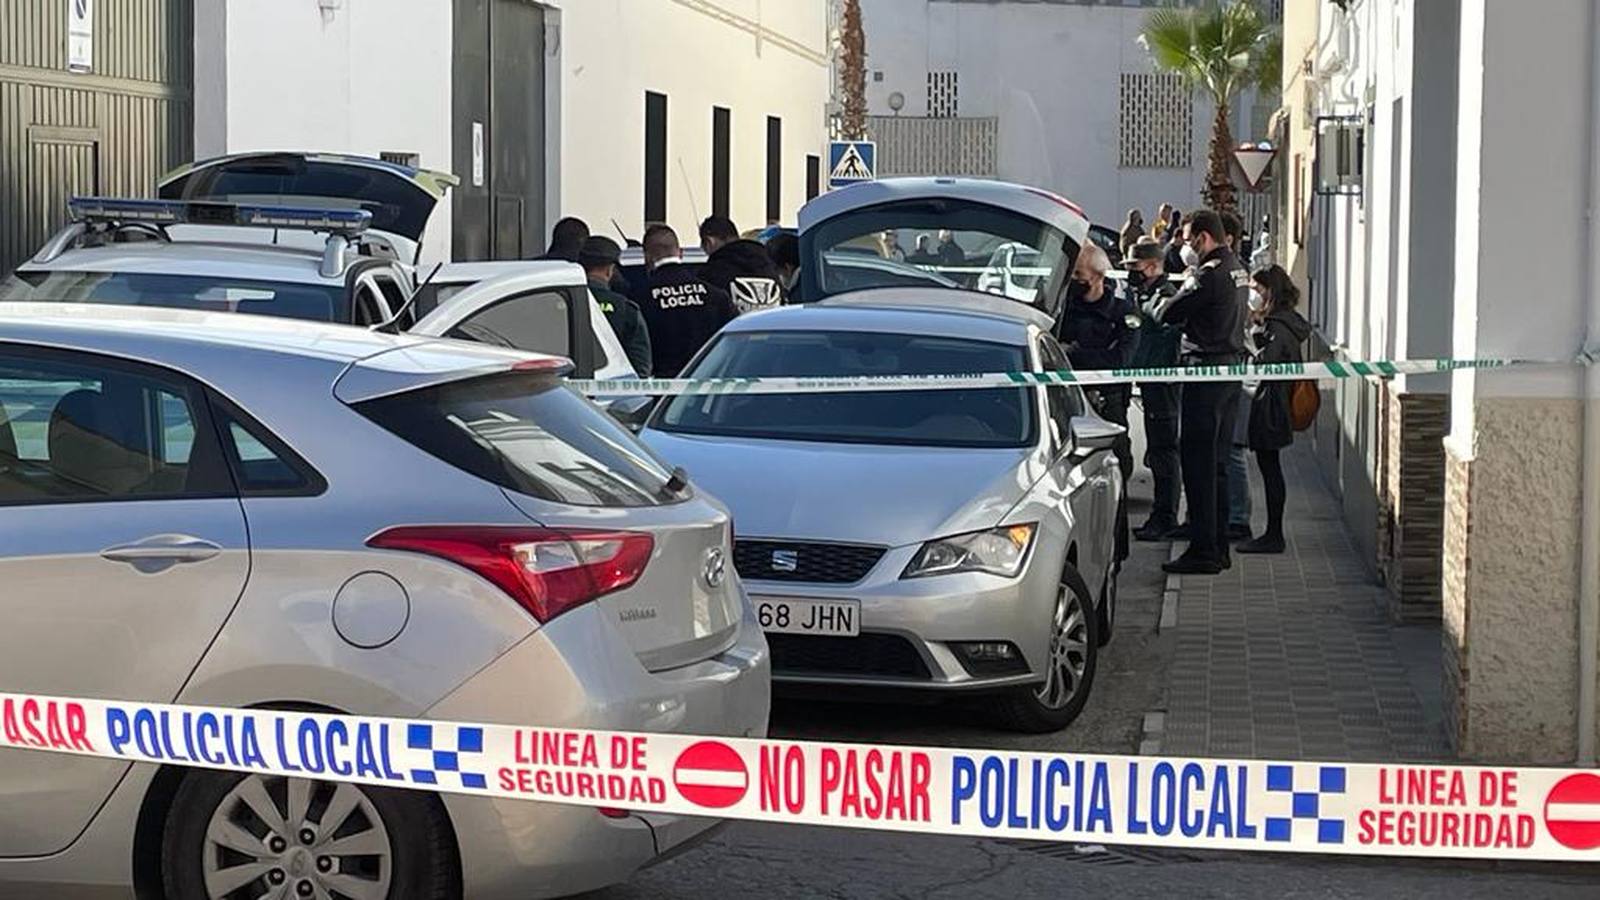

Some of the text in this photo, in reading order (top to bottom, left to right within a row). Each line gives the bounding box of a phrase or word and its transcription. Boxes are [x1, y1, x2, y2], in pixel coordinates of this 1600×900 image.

[651, 283, 708, 300] POLICIA
[660, 294, 705, 309] LOCAL
[758, 603, 853, 633] 68 JHN
[4, 698, 405, 782] ASAR POLICIA LOCAL
[514, 730, 647, 771] LINEA DE
[498, 767, 667, 804] SEGURIDAD
[759, 744, 1257, 839] NO PASAR POLICIA LOCAL
[1378, 767, 1518, 808] LINEA DE
[1357, 808, 1536, 849] SEGURIDAD
